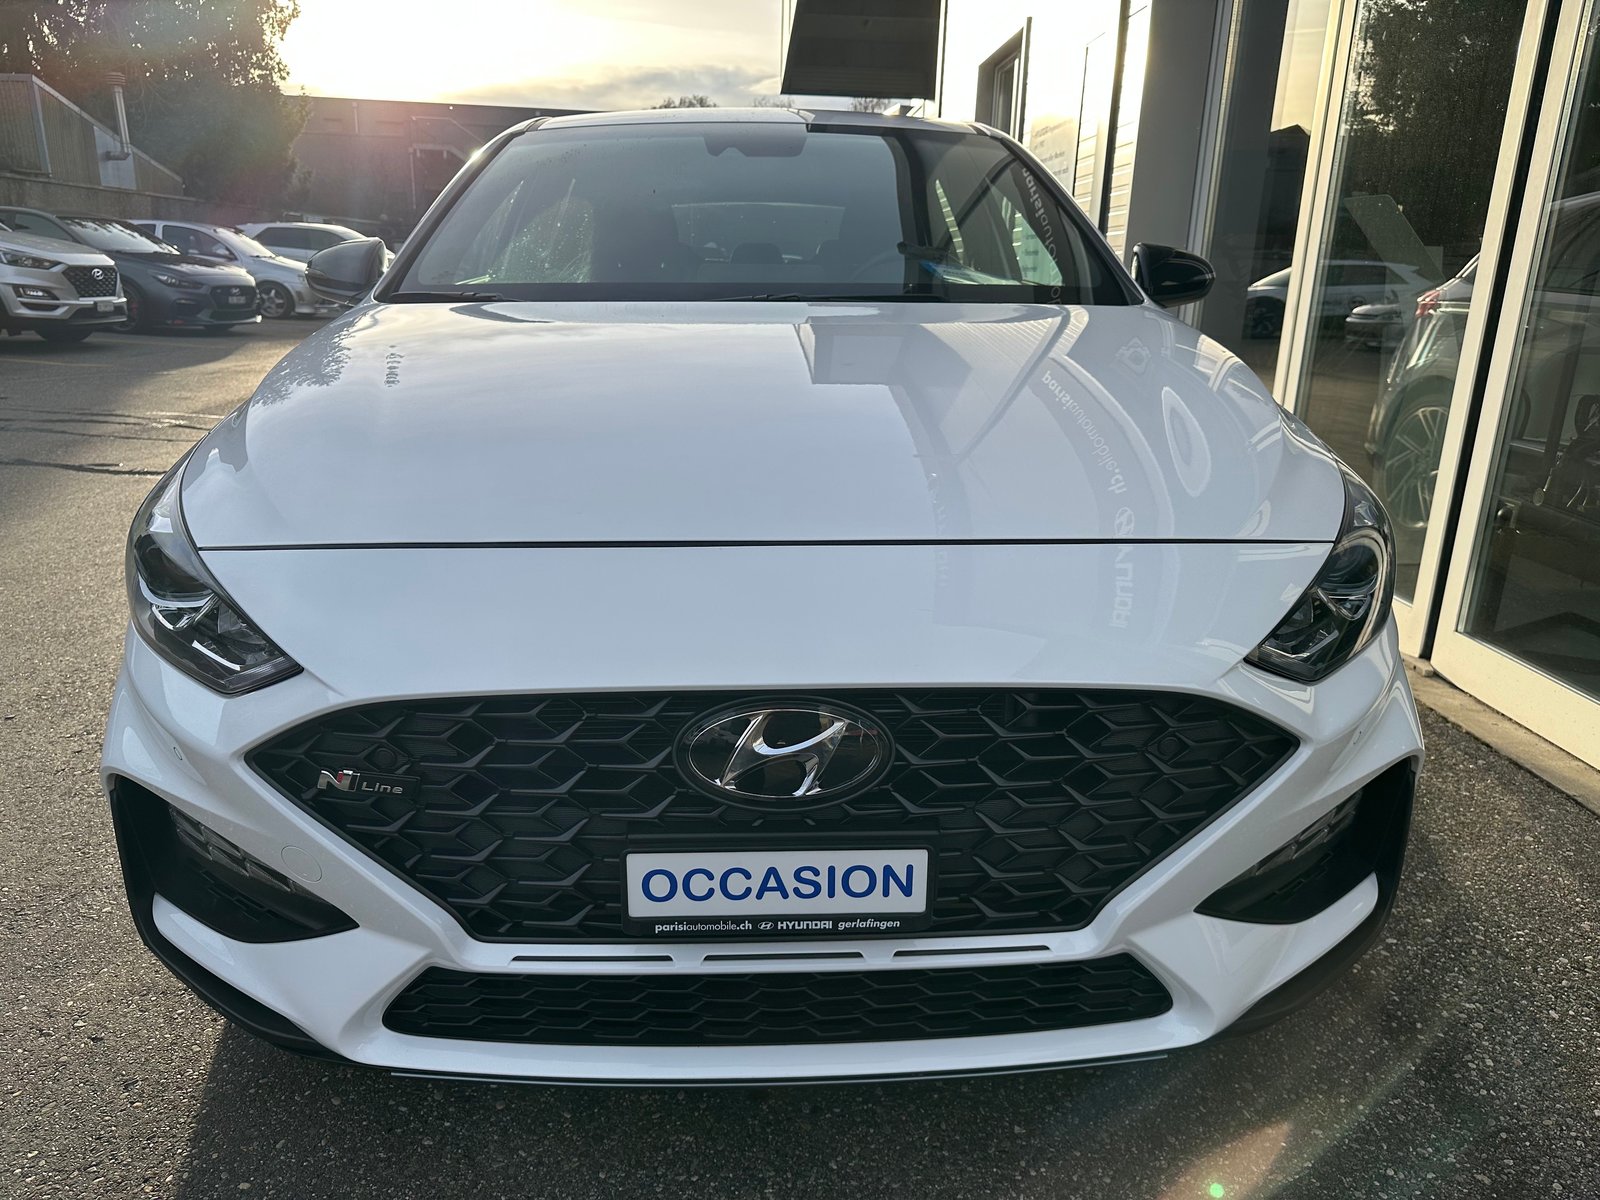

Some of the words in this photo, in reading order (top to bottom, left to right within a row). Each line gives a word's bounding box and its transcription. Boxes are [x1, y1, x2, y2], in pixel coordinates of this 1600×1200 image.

[317, 769, 360, 791] N
[362, 782, 403, 794] Line
[641, 864, 914, 902] OCCASION
[655, 921, 752, 933] parisiautomobile.ch
[777, 920, 832, 930] HYUNDAI
[838, 919, 901, 931] gerlafingen
